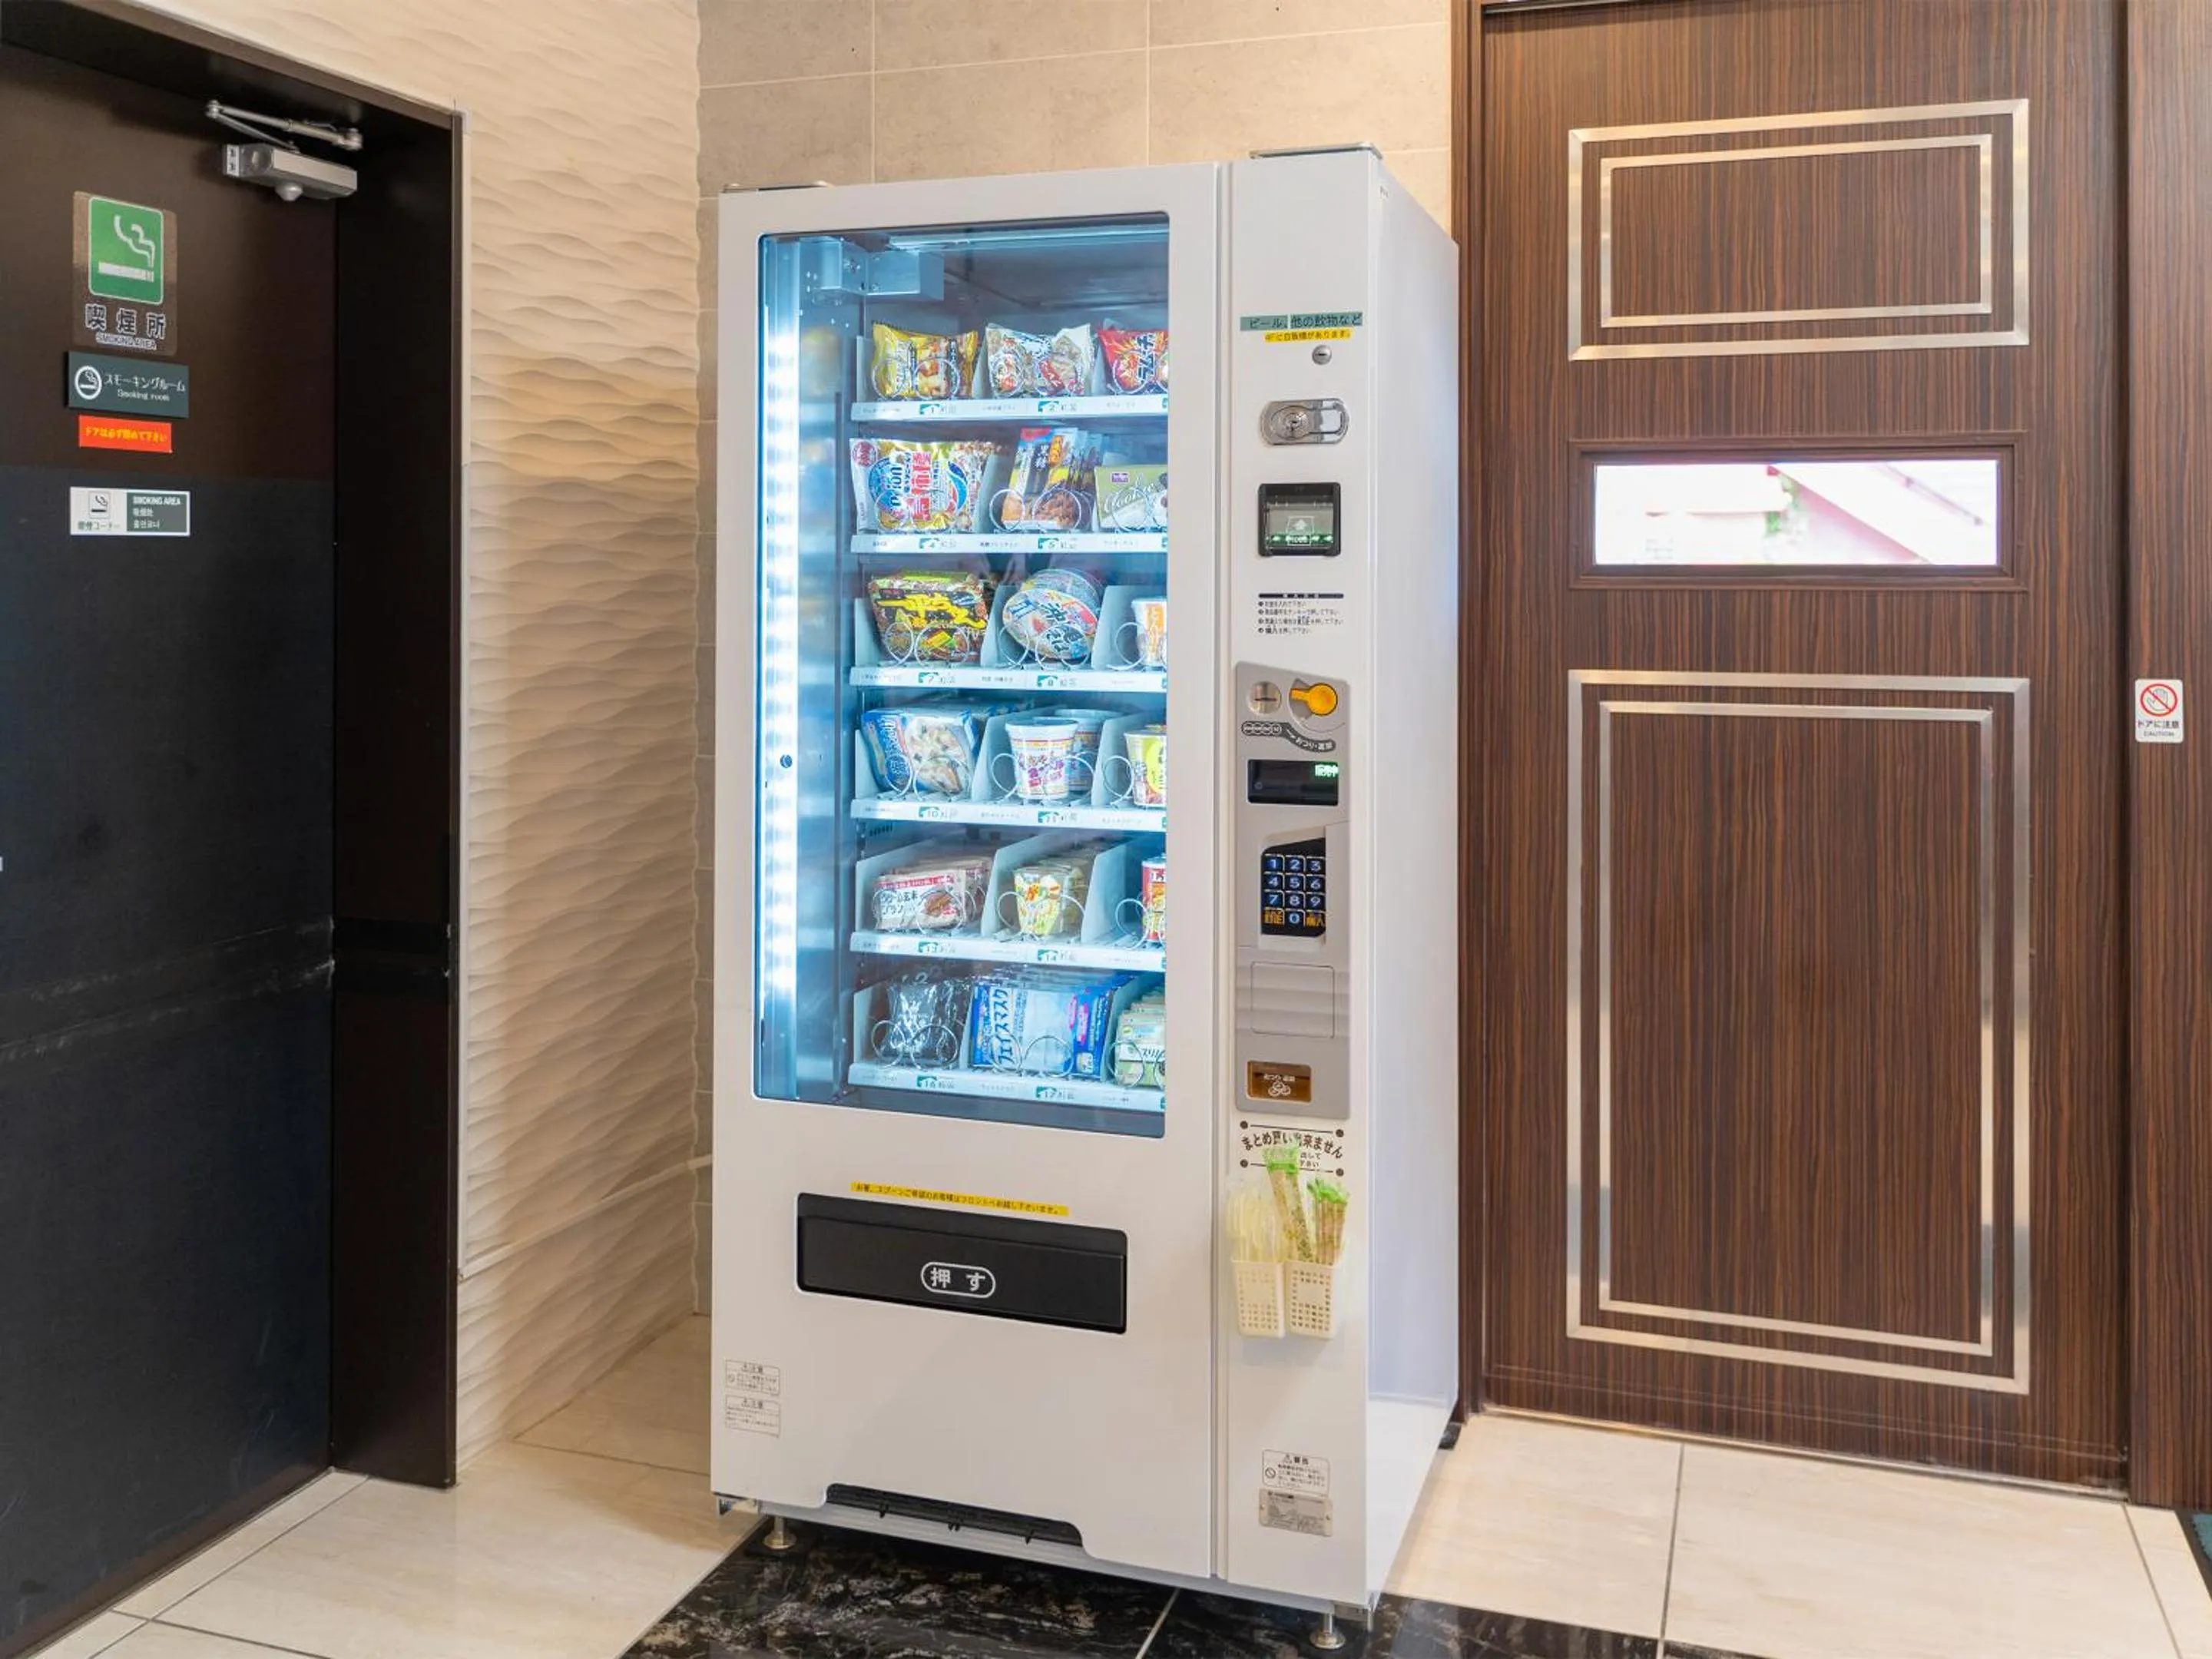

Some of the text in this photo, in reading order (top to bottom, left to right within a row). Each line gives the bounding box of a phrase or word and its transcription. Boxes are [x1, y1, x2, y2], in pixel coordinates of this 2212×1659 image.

[85, 303, 166, 339] 喫煙所
[104, 373, 185, 392] スモーキングルーム
[118, 389, 148, 400] Smoking
[133, 495, 181, 506] SMOKING AREA
[1270, 859, 1321, 872] 1 2 3
[1268, 876, 1321, 889] 4 5 6
[1269, 895, 1321, 907] 7 8 9
[1289, 912, 1300, 924] 0
[993, 988, 1015, 1064] フェイスマスク
[930, 1267, 985, 1291] 押す
